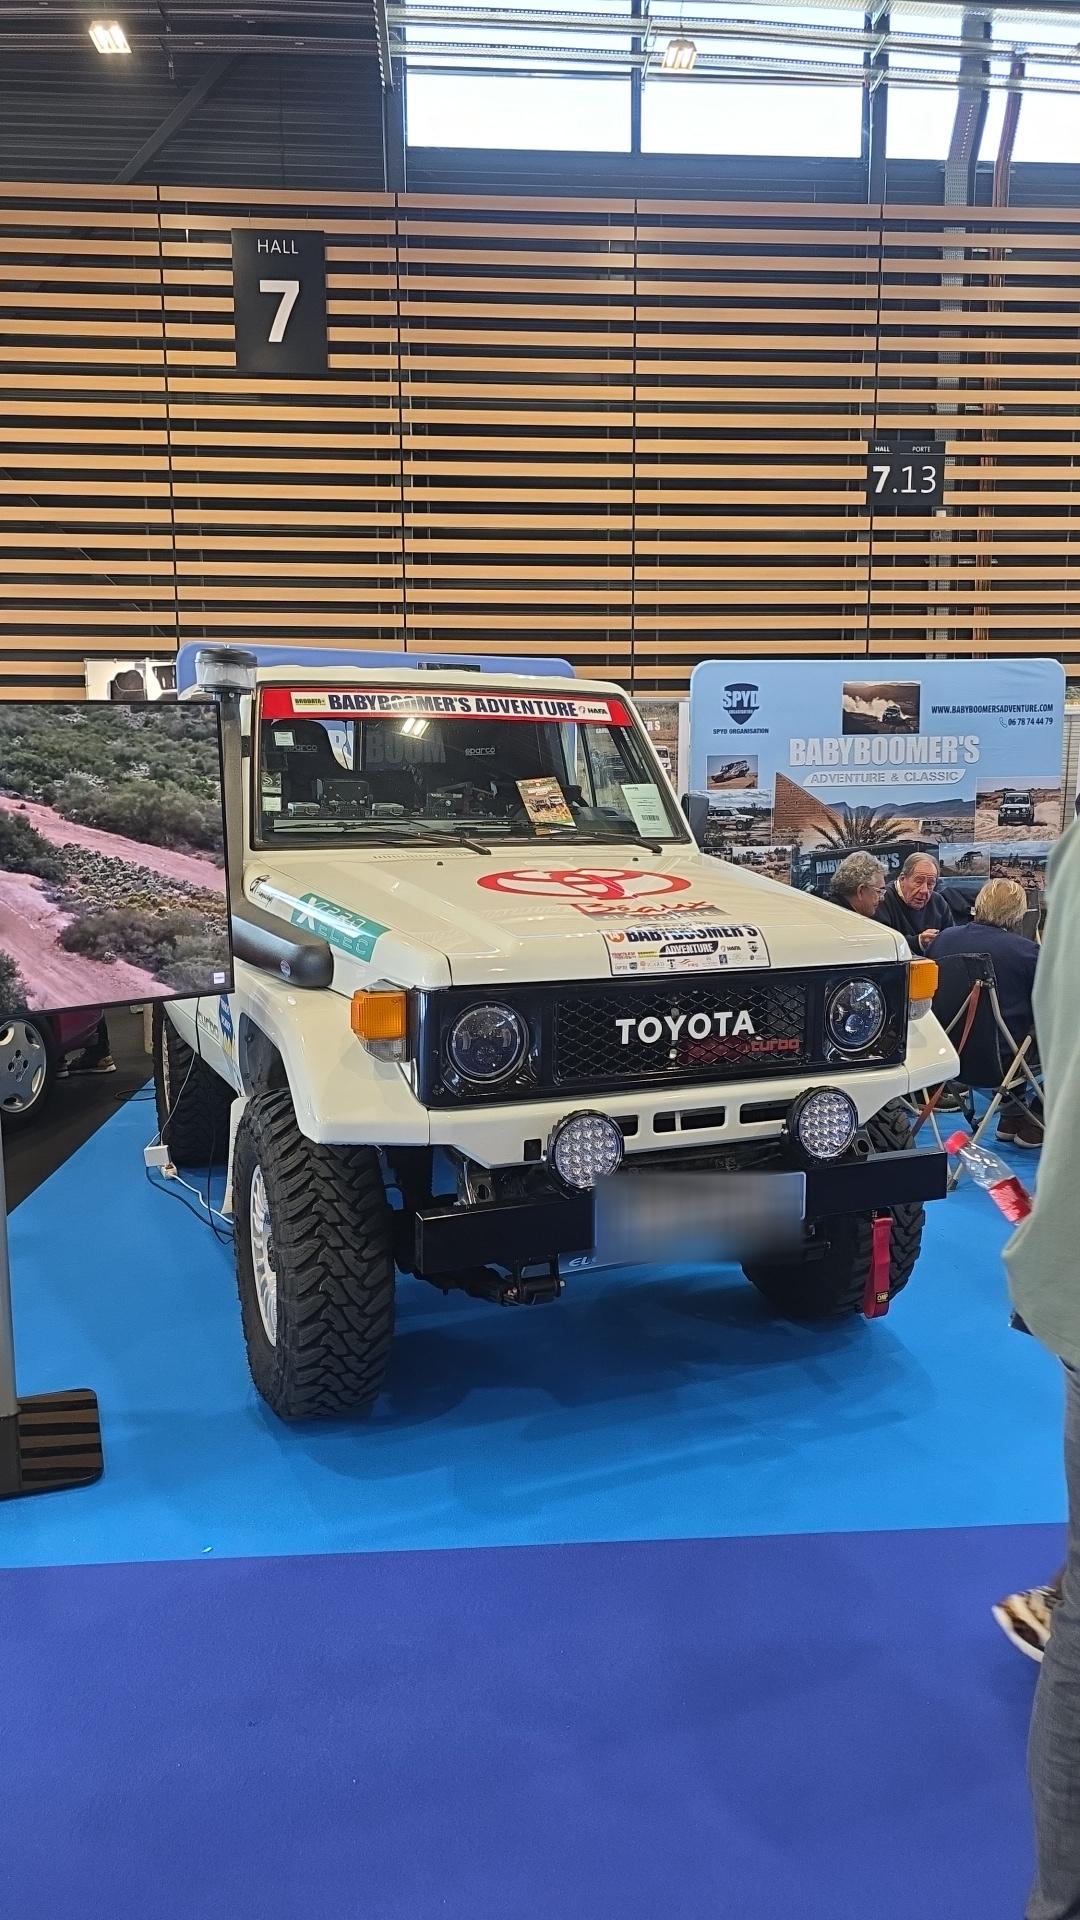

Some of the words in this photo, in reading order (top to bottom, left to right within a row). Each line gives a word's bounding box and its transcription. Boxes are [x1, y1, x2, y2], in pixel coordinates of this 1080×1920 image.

[257, 239, 299, 254] HALL
[259, 279, 300, 342] 7
[872, 465, 937, 493] 7.13
[328, 694, 472, 712] BABYBOOMER'S
[475, 697, 579, 717] ADVENTURE
[723, 690, 760, 708] SPYD
[931, 704, 1054, 714] WWW.BABYBOOMERSADVENTURE.COM
[1007, 718, 1016, 726] 06
[1017, 718, 1026, 726] 78
[1035, 717, 1044, 725] 44
[1045, 717, 1054, 725] 79
[464, 747, 496, 756] sparco
[789, 736, 980, 766] BABYBOOMER'S
[810, 772, 885, 784] ADVENTURE
[890, 772, 899, 782] &
[903, 771, 959, 782] CLASSIC
[664, 942, 715, 955] ADVENTURE
[615, 1010, 756, 1045] TOYOTA
